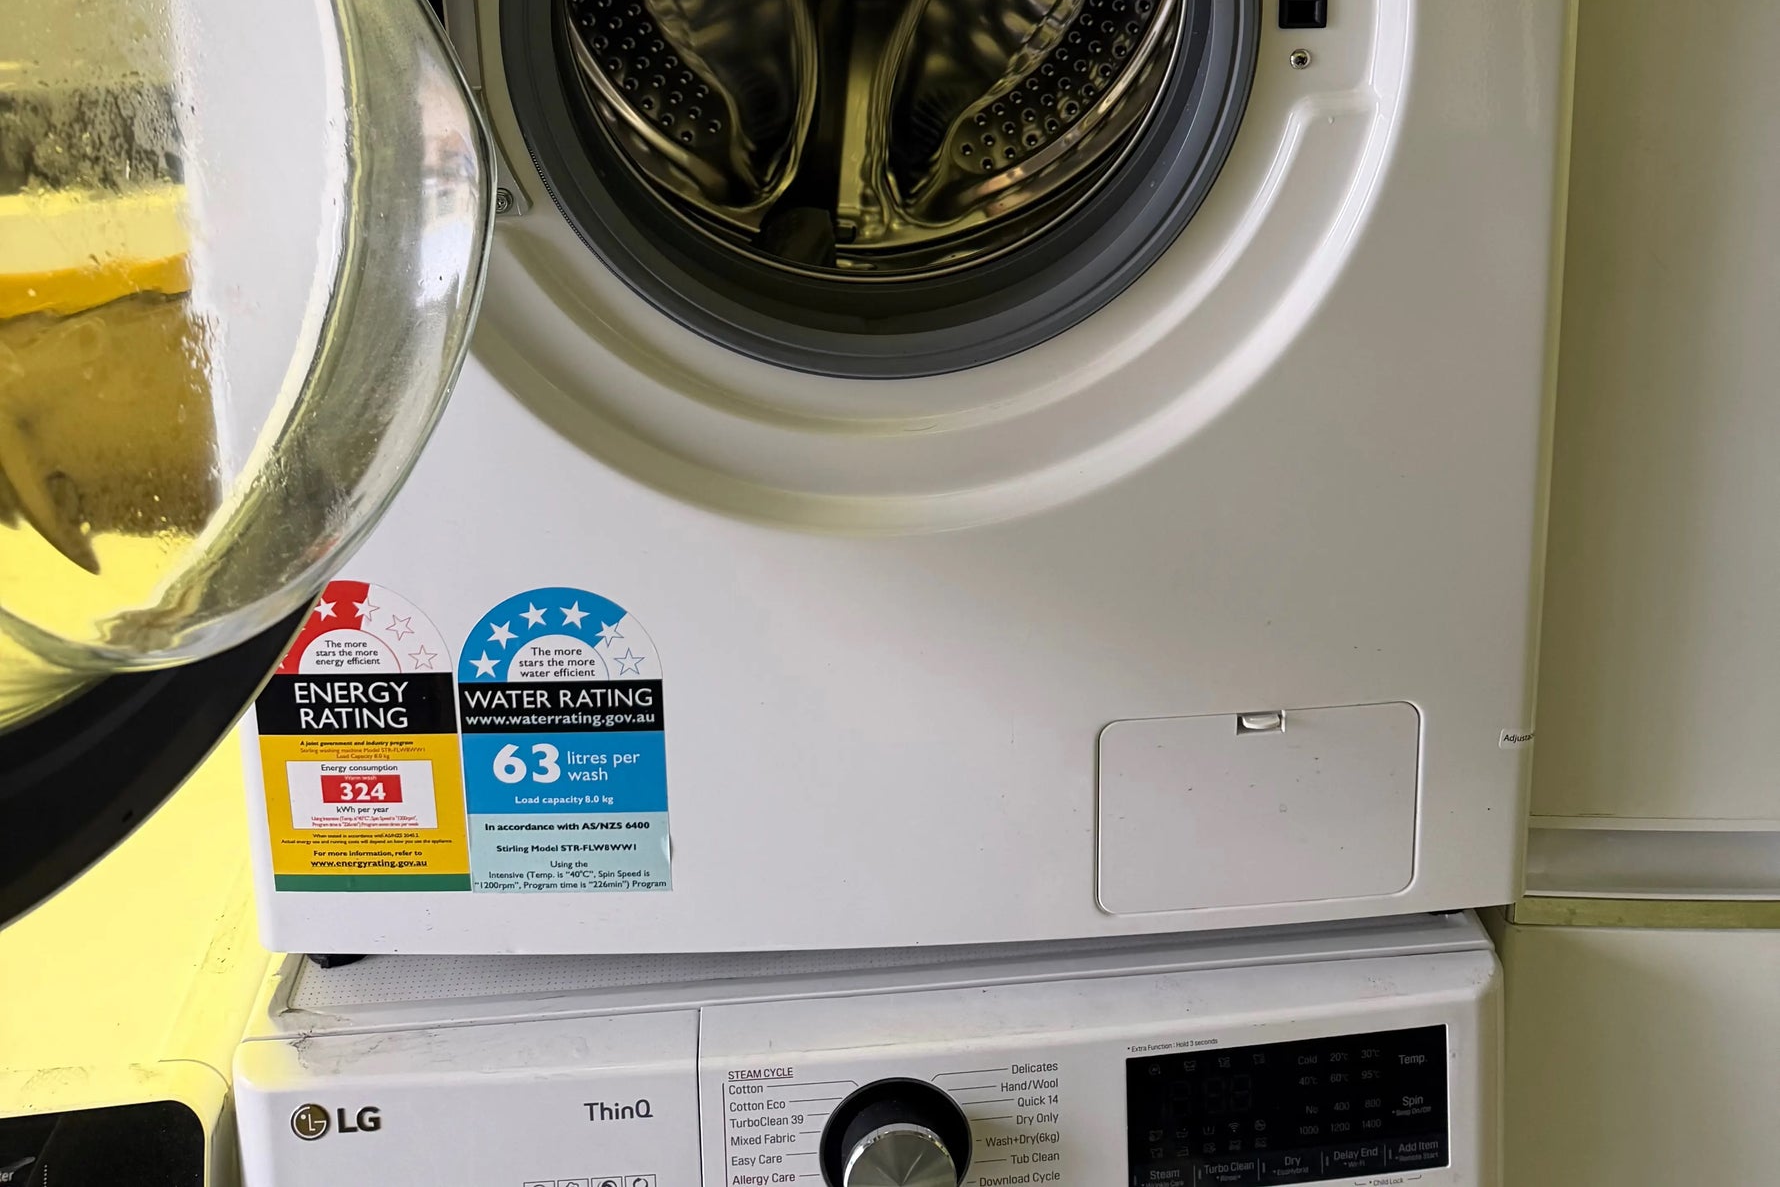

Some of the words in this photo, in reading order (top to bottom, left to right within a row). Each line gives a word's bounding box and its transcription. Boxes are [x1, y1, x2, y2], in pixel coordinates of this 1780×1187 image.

[325, 640, 341, 648] The
[531, 647, 551, 656] The
[554, 648, 582, 656] more
[316, 658, 344, 667] energy
[347, 657, 380, 665] efficient
[519, 659, 543, 667] stars
[547, 658, 564, 666] the
[520, 670, 550, 678] water
[553, 668, 595, 677] efficient
[294, 681, 409, 704] ENERGY
[464, 690, 552, 709] WATER
[559, 687, 653, 708] RATING
[300, 707, 409, 729] RATING
[466, 711, 655, 727] www.waterrating.gov.au
[492, 743, 561, 783] 63
[567, 751, 607, 765] litres
[613, 753, 640, 768] per
[321, 764, 347, 773] Energy
[348, 765, 398, 773] consumption
[568, 767, 608, 781] wash
[340, 782, 386, 801] 324
[515, 796, 540, 804] Load
[542, 795, 584, 805] capacity
[585, 795, 599, 803] 8.0
[602, 795, 614, 805] kg
[336, 806, 355, 814] kWh
[358, 807, 370, 815] per
[373, 807, 389, 815] year
[498, 823, 554, 831] accordance
[557, 822, 579, 830] with
[582, 822, 622, 830] AS/NZS
[625, 821, 650, 829] 6400
[349, 850, 394, 858] information,
[496, 845, 529, 853] Stirling
[311, 859, 427, 868] www.energyrating.gov.au
[550, 860, 573, 869] Using
[575, 860, 588, 868] the
[489, 871, 524, 879] Intensive
[526, 871, 555, 880] (Temp.
[557, 871, 564, 879] is
[598, 870, 615, 879] Spin
[617, 870, 642, 879] Speed
[643, 870, 650, 878] is
[523, 882, 558, 891] Program
[560, 881, 579, 889] time
[580, 881, 587, 889] is
[632, 880, 667, 889] Program
[1148, 1043, 1173, 1051] Function
[1195, 1039, 1218, 1047] seconds
[1298, 1056, 1317, 1065] Cold
[1398, 1055, 1428, 1065] Temp.
[728, 1070, 761, 1080] STEAM
[764, 1068, 793, 1078] CYCLE
[1012, 1063, 1058, 1074] Delicates
[729, 1084, 763, 1095] Cotton
[1001, 1078, 1059, 1092] Hand/Wool
[729, 1101, 764, 1112] Cotton
[767, 1100, 786, 1110] Eco
[1018, 1096, 1045, 1107] Quick
[1048, 1095, 1059, 1105] 14
[1333, 1102, 1350, 1111] 400
[1364, 1098, 1381, 1108] 800
[1402, 1096, 1424, 1107] Spin
[583, 1099, 653, 1121] ThinQ
[1306, 1106, 1319, 1114] No
[337, 1106, 381, 1133] LG
[730, 1116, 789, 1128] TurboClean
[791, 1114, 804, 1124] 39
[1017, 1115, 1034, 1125] Dry
[1037, 1113, 1059, 1124] Only
[1362, 1119, 1381, 1129] 1400
[1299, 1126, 1319, 1135] 1000
[1331, 1122, 1350, 1132] 1200
[730, 1134, 761, 1146] Mixed
[764, 1133, 796, 1144] Fabric
[986, 1131, 1060, 1147] Wash+Dry(6kg)
[1399, 1143, 1417, 1153] Add
[1419, 1141, 1439, 1151] Item
[1011, 1154, 1029, 1164] Tub
[1032, 1152, 1060, 1163] Clean
[1333, 1150, 1359, 1161] Delay
[1361, 1147, 1378, 1157] End
[731, 1155, 756, 1166] Easy
[759, 1154, 782, 1164] Care
[1284, 1156, 1301, 1167] Dry
[1204, 1164, 1229, 1175] Turbo
[1230, 1161, 1255, 1172] Clean
[732, 1174, 769, 1186] Allergy
[772, 1173, 796, 1183] Care
[980, 1174, 1030, 1187] Download
[1032, 1171, 1060, 1184] Cycle
[1150, 1169, 1180, 1180] Steam
